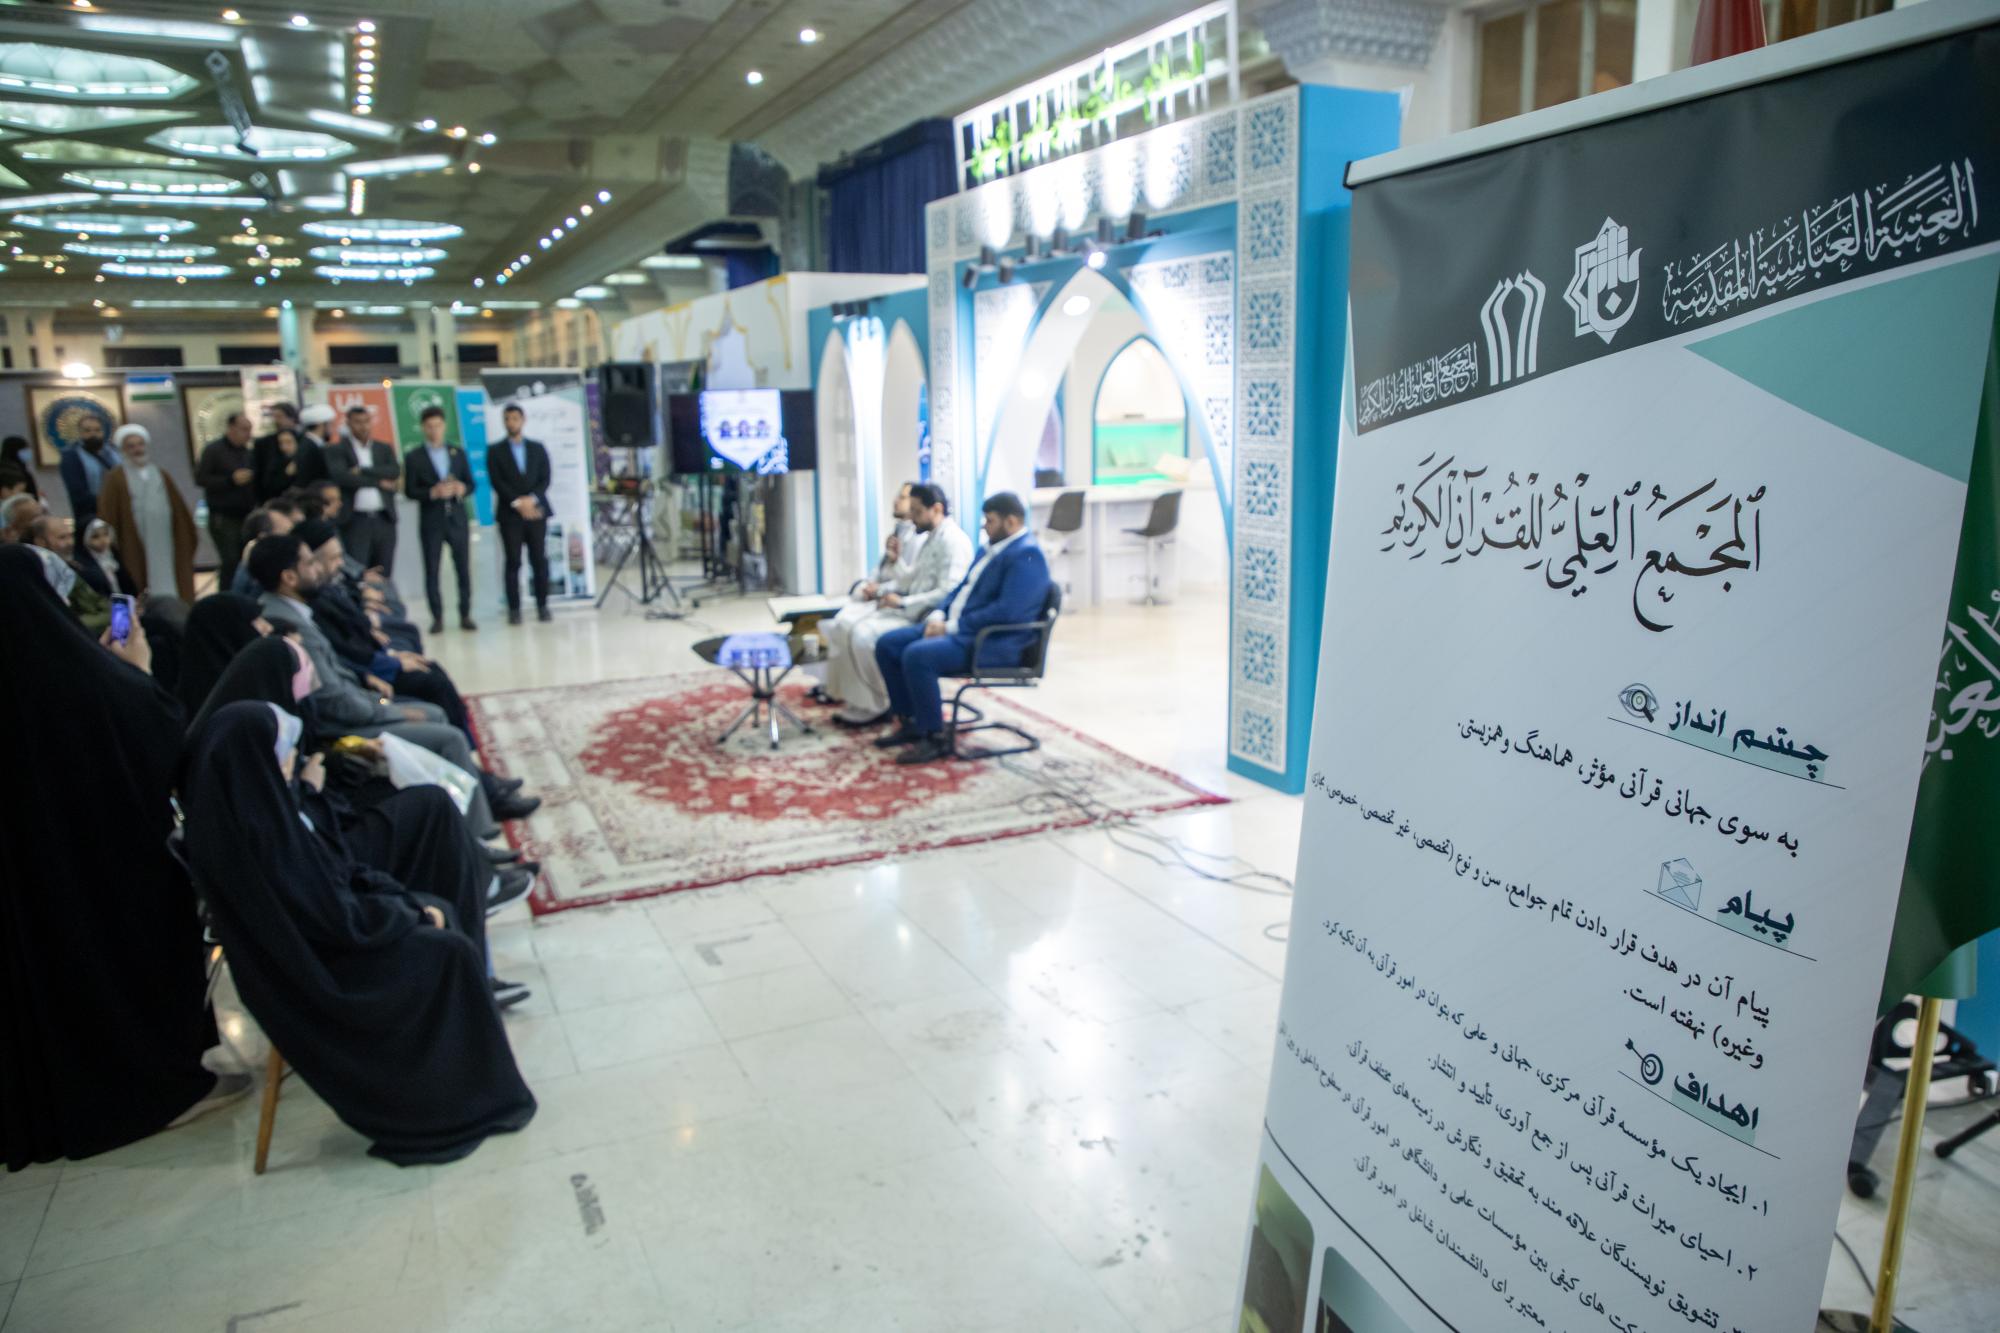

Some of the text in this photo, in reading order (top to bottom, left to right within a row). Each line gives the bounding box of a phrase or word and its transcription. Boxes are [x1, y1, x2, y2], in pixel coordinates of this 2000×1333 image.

[1669, 701, 1726, 737] انداز
[1514, 730, 1572, 767] هماهنگ
[1620, 768, 1663, 807] قرآنی
[1665, 789, 1711, 824] جهانی
[1396, 820, 1410, 837] غیر
[1718, 817, 1769, 844] سوی
[1777, 832, 1798, 857] به
[1455, 854, 1471, 876] نوع
[1473, 868, 1479, 880] و
[1482, 871, 1500, 887] سن
[1506, 884, 1547, 909] جوامع،
[1551, 899, 1573, 921] تمام
[1718, 890, 1794, 943] پیام
[1576, 910, 1607, 937] دادن
[1610, 929, 1637, 955] قرار
[1376, 954, 1396, 978] قرآنی
[1641, 945, 1677, 974] هدف
[1396, 976, 1414, 989] امور
[1681, 974, 1701, 988] در
[1708, 976, 1734, 1000] آن
[1416, 989, 1425, 1000] در
[1624, 988, 1665, 1014] است.
[1452, 1013, 1464, 1025] که
[1737, 991, 1769, 1028] پیام
[1464, 1024, 1487, 1040] علمی
[1670, 1009, 1705, 1040] نهفته
[1490, 1043, 1498, 1054] و
[1501, 1045, 1532, 1071] جهانی
[1458, 1082, 1465, 1093] و
[1537, 1070, 1580, 1102] مرکزی،
[1583, 1095, 1616, 1126] قرآنی
[1674, 1072, 1759, 1130] اهداف
[1434, 1121, 1445, 1131] در
[1447, 1129, 1481, 1156] نگارش
[1532, 1129, 1552, 1151] جمع
[1555, 1142, 1568, 1160] از
[1618, 1121, 1665, 1158] مؤسسه
[1483, 1158, 1491, 1169] و
[1494, 1162, 1525, 1187] تحقیق
[1571, 1161, 1592, 1185] پس
[1671, 1157, 1701, 1185] یک
[1440, 1183, 1447, 1194] و
[1450, 1190, 1474, 1207] علمی
[1528, 1186, 1538, 1204] به
[1595, 1171, 1629, 1202] قرآنی
[1707, 1173, 1746, 1204] ایجاد
[1542, 1197, 1562, 1216] مند
[1632, 1194, 1675, 1235] میراث
[1477, 1208, 1527, 1251] مؤسسات
[1566, 1213, 1596, 1241] علاقه
[1530, 1250, 1547, 1272] بین
[1680, 1233, 1731, 1267] احیای
[1601, 1238, 1665, 1296] نویسندگان
[1550, 1269, 1580, 1292] کیفی
[1579, 1292, 1604, 1314] های
[1668, 1293, 1719, 1328] تشویق
